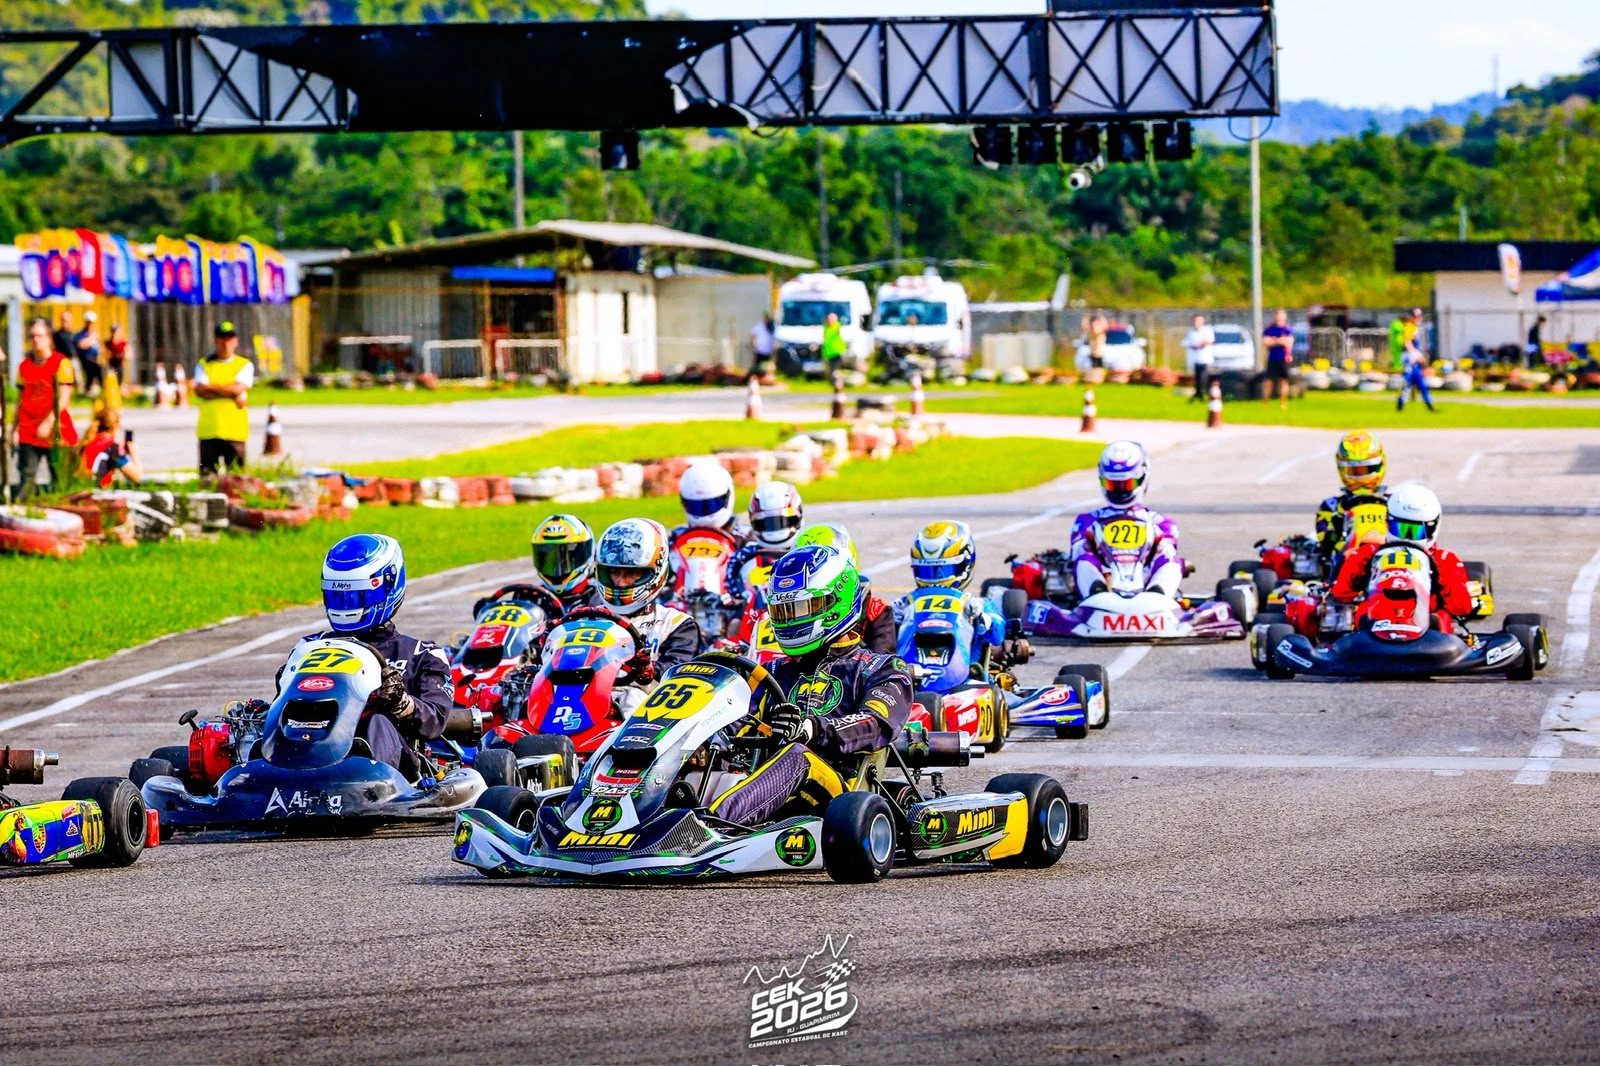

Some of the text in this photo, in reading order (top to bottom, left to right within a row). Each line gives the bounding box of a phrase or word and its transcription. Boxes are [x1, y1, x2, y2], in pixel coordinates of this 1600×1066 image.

[1110, 524, 1140, 544] 227
[1388, 552, 1412, 565] 11
[921, 598, 953, 609] 14
[1103, 615, 1165, 631] MAXI
[563, 629, 606, 644] 19
[299, 652, 355, 669] 27
[645, 683, 699, 709] 65
[591, 806, 613, 818] M
[926, 818, 941, 829] M
[784, 834, 805, 849] M
